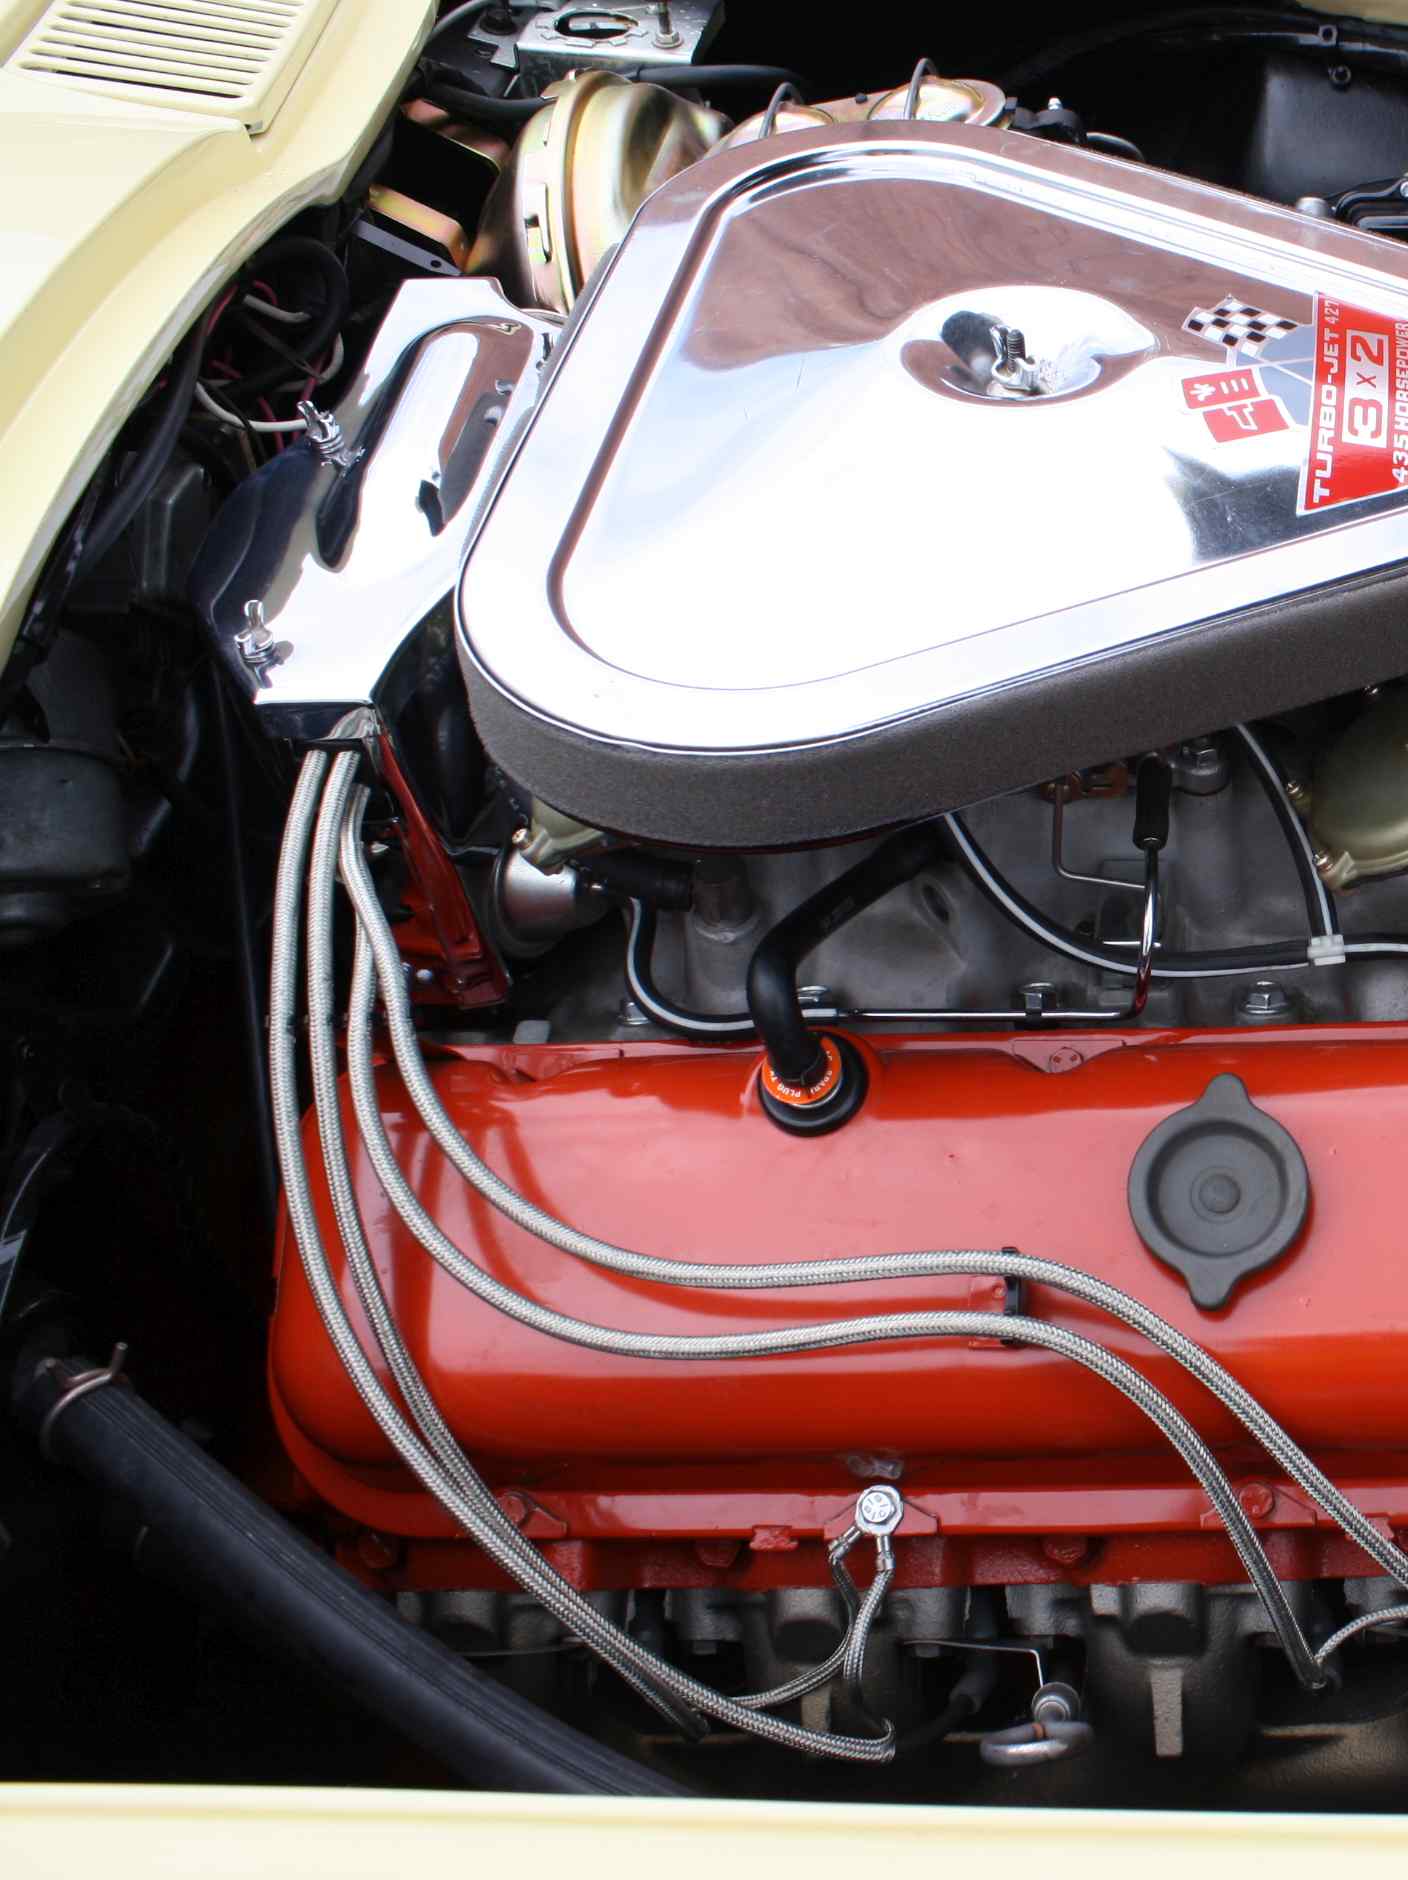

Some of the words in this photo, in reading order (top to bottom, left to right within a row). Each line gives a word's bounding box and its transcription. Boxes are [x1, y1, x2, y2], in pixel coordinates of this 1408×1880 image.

[1323, 299, 1340, 324] 427
[1350, 336, 1386, 368] 2
[1312, 328, 1340, 504] TURBO-JET
